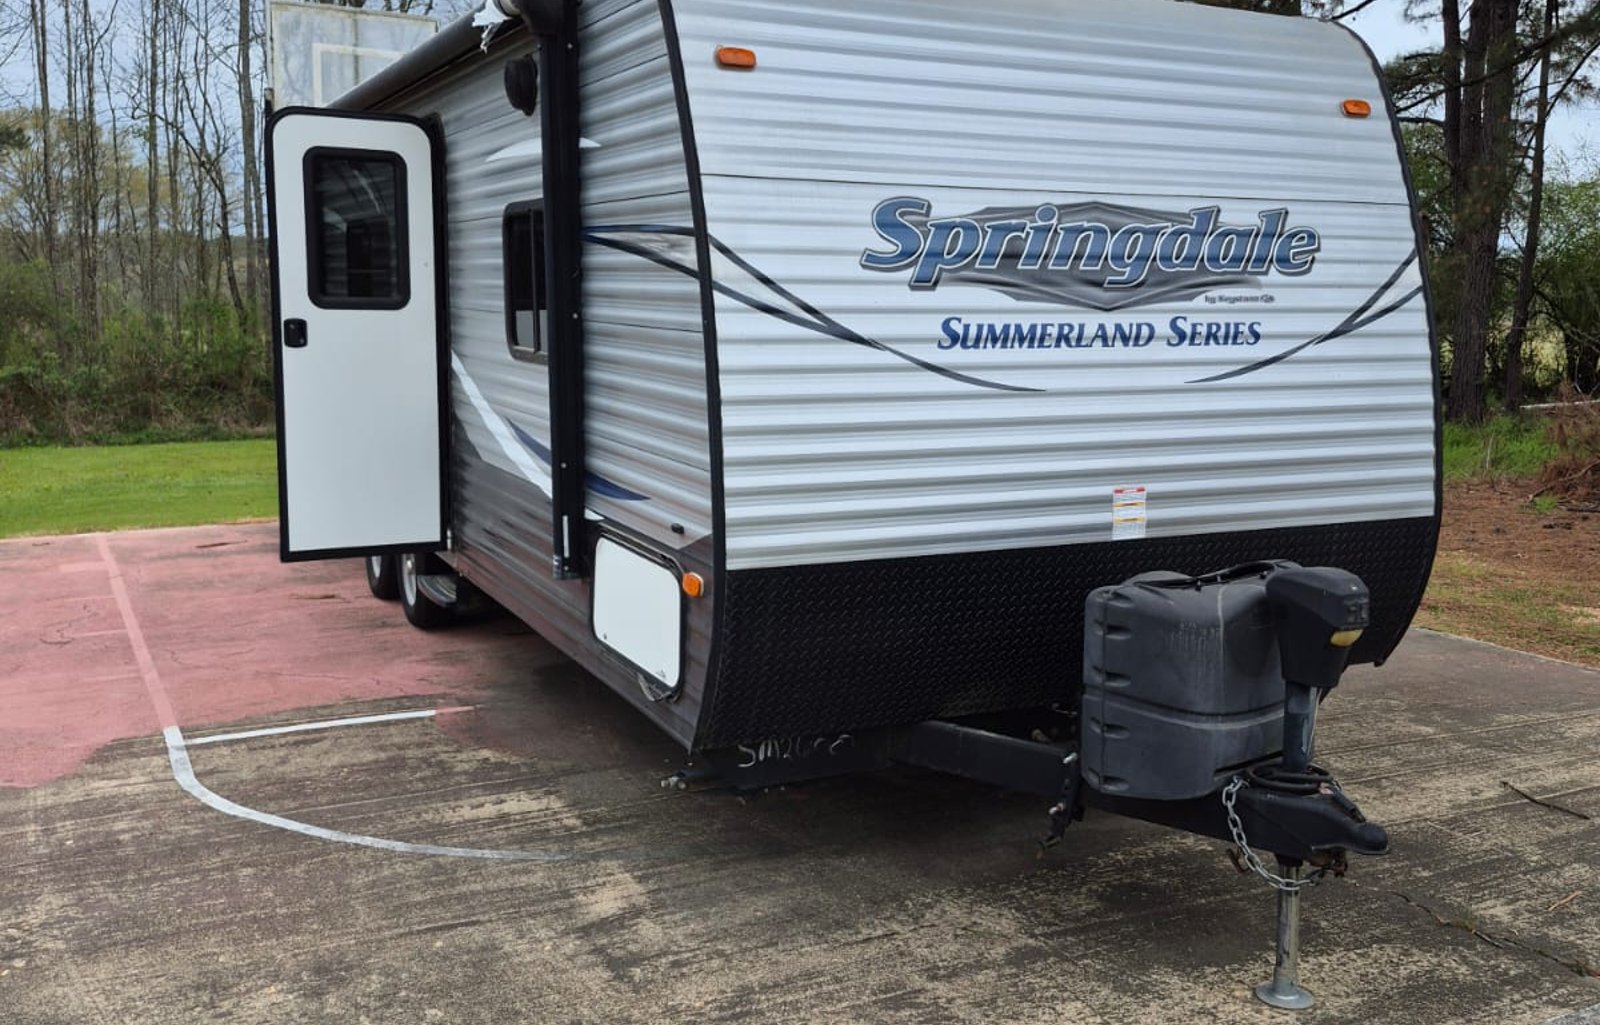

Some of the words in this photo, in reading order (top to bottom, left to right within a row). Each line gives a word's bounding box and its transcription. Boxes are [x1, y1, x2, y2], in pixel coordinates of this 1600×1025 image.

[860, 196, 1320, 290] Springdale
[937, 317, 1155, 350] SUMMERLAND
[1166, 316, 1262, 346] SERIES
